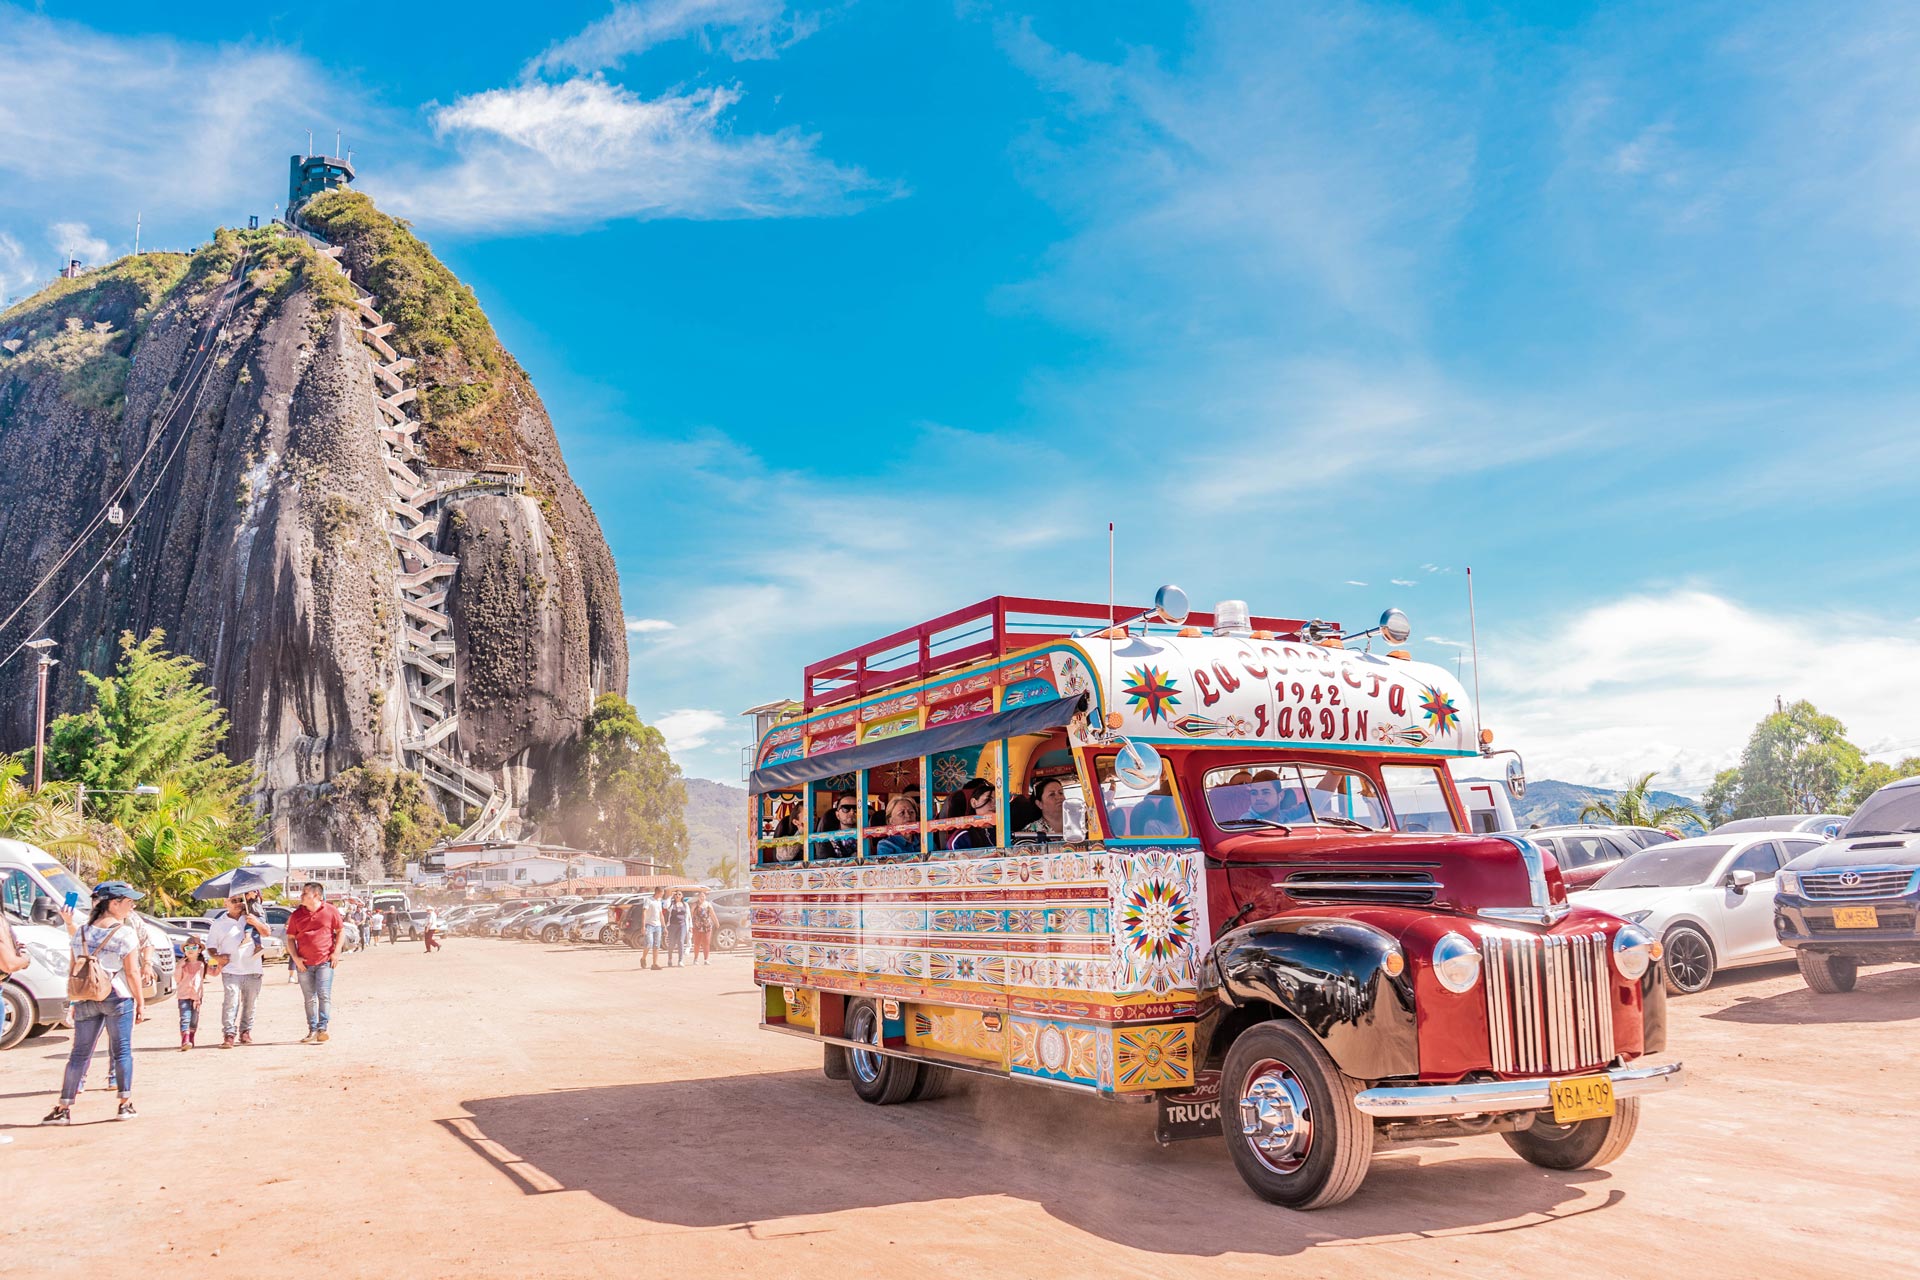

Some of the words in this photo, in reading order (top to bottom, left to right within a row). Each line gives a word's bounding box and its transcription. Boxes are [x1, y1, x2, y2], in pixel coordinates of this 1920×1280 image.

[1194, 658, 1241, 707] LA
[1275, 681, 1341, 705] 1942
[1254, 703, 1369, 741] JARDIN
[1555, 1082, 1610, 1110] KBA-409
